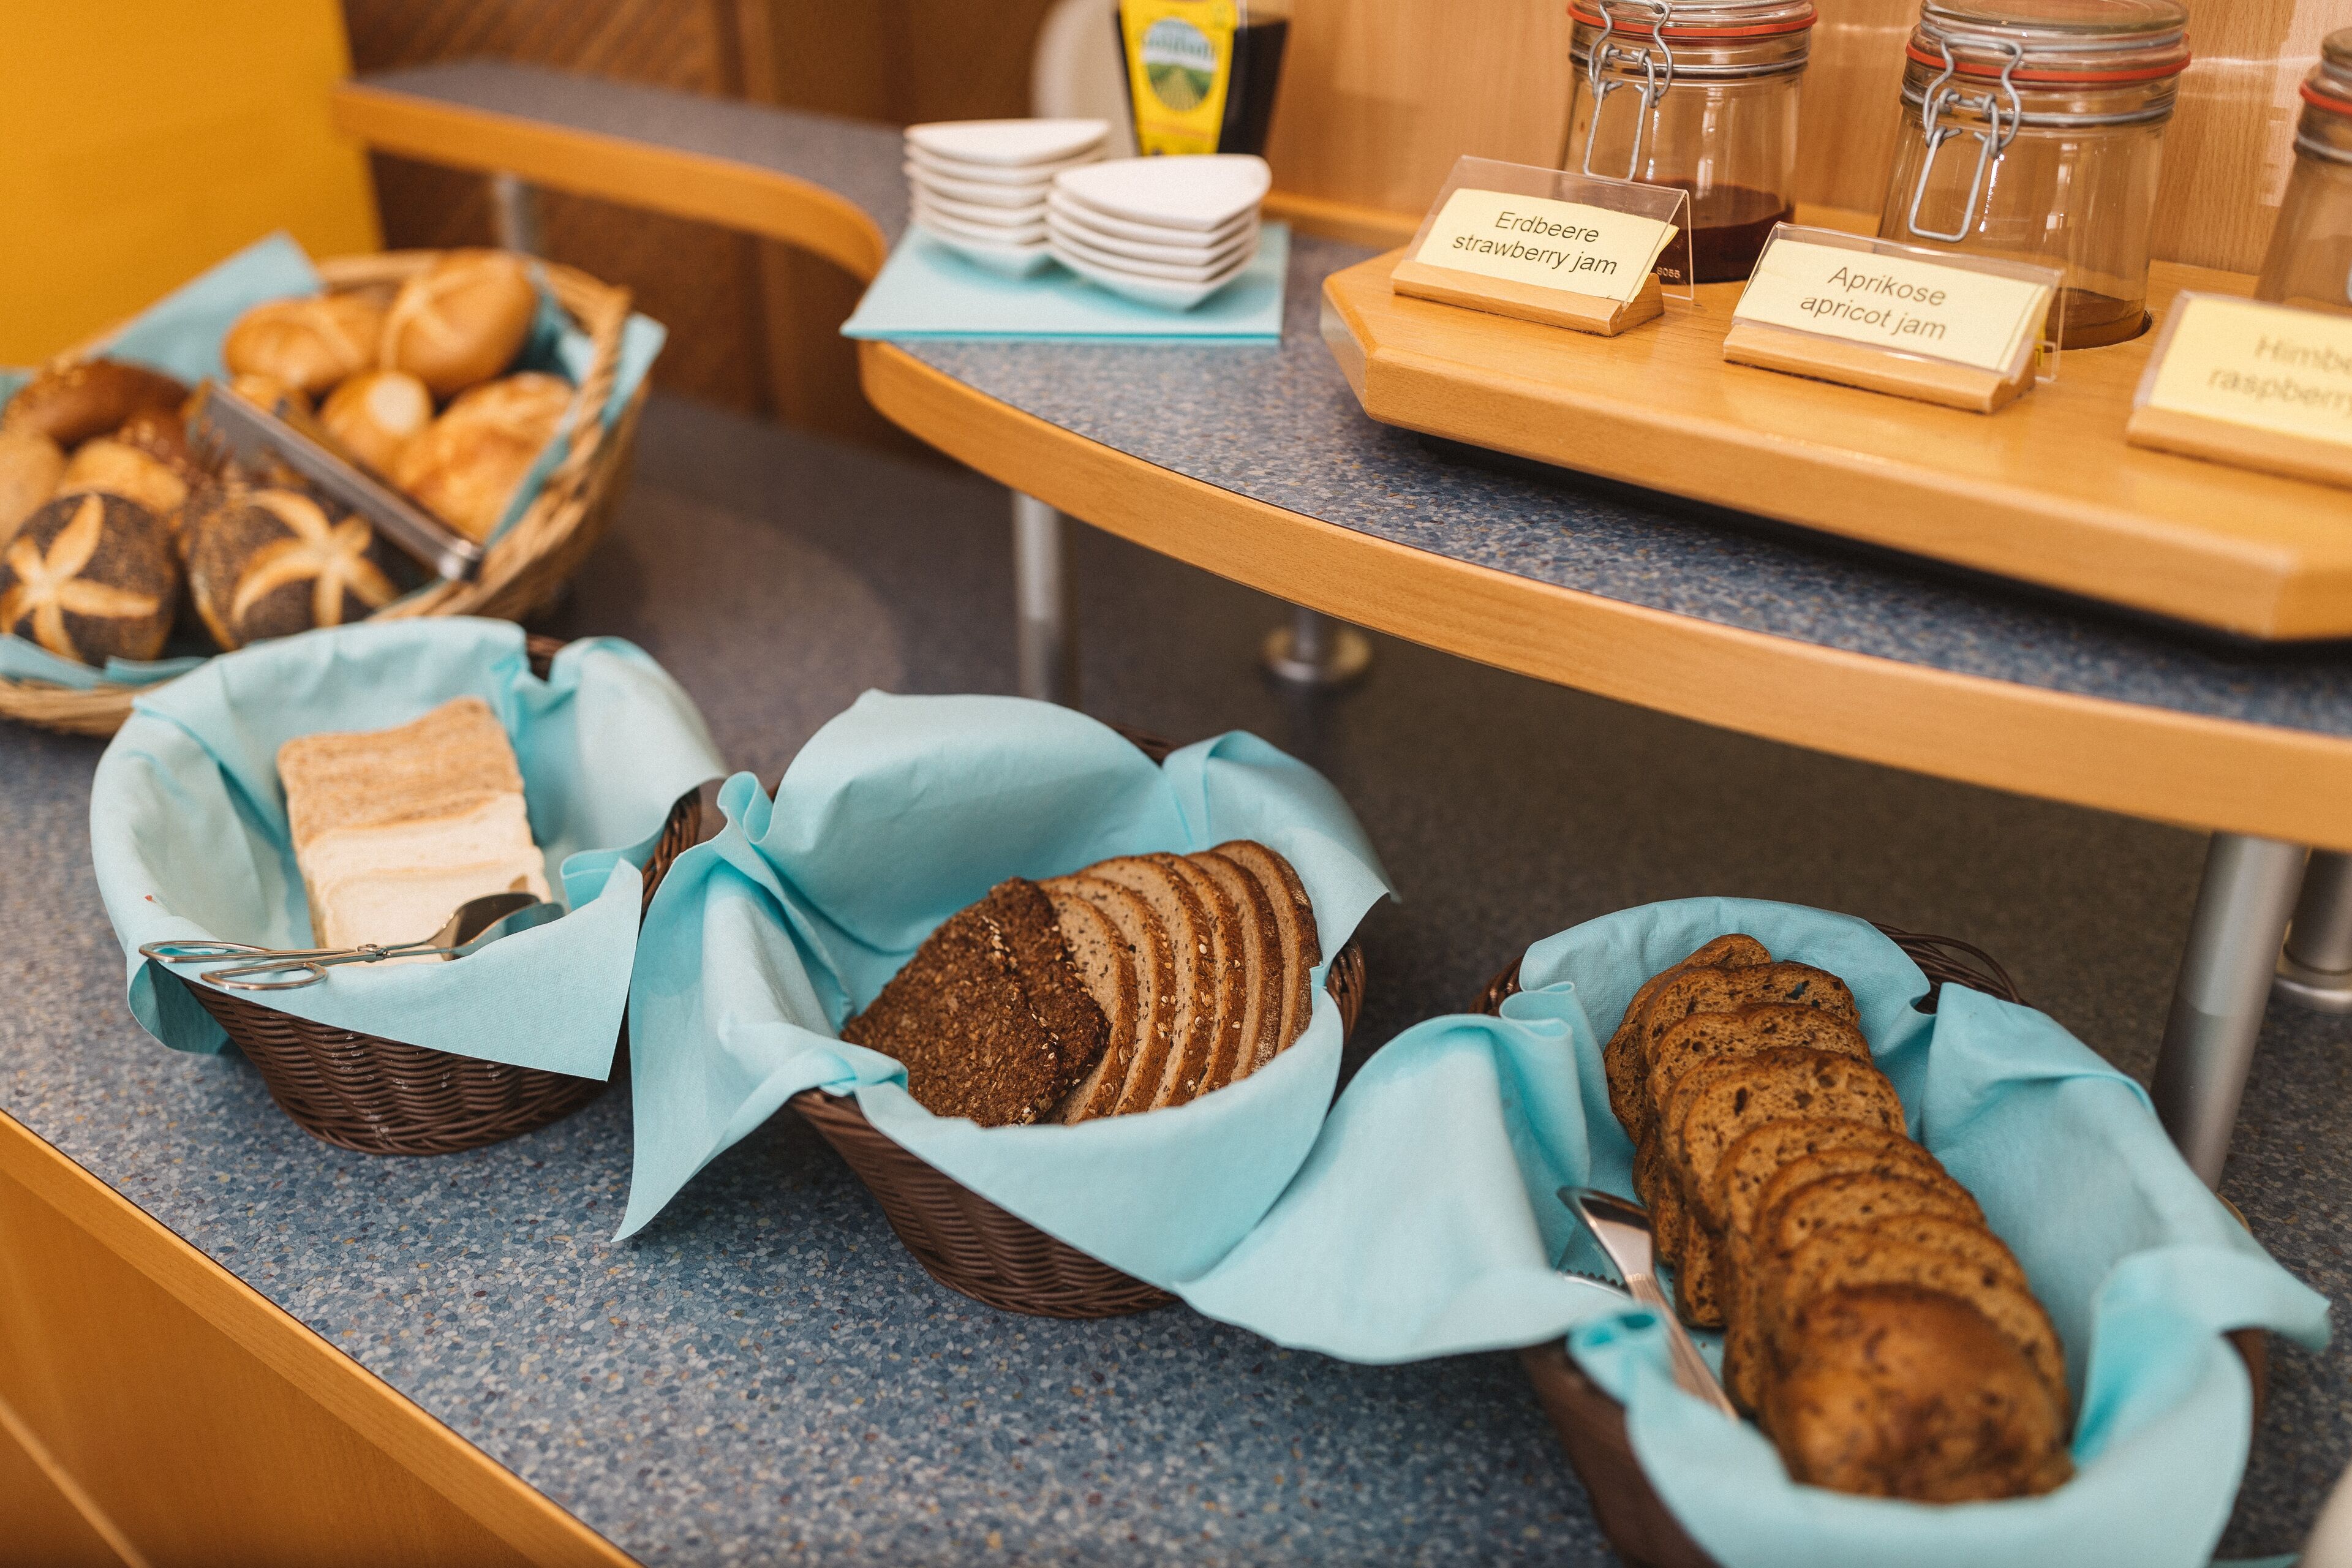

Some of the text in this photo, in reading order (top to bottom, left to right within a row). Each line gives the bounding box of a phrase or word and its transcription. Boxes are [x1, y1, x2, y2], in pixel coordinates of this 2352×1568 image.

[1495, 211, 1599, 243] Erdbeere
[1452, 234, 1618, 275] strawberry jam
[1827, 266, 1947, 306] Aprikose
[1801, 296, 1947, 340] apricot jam
